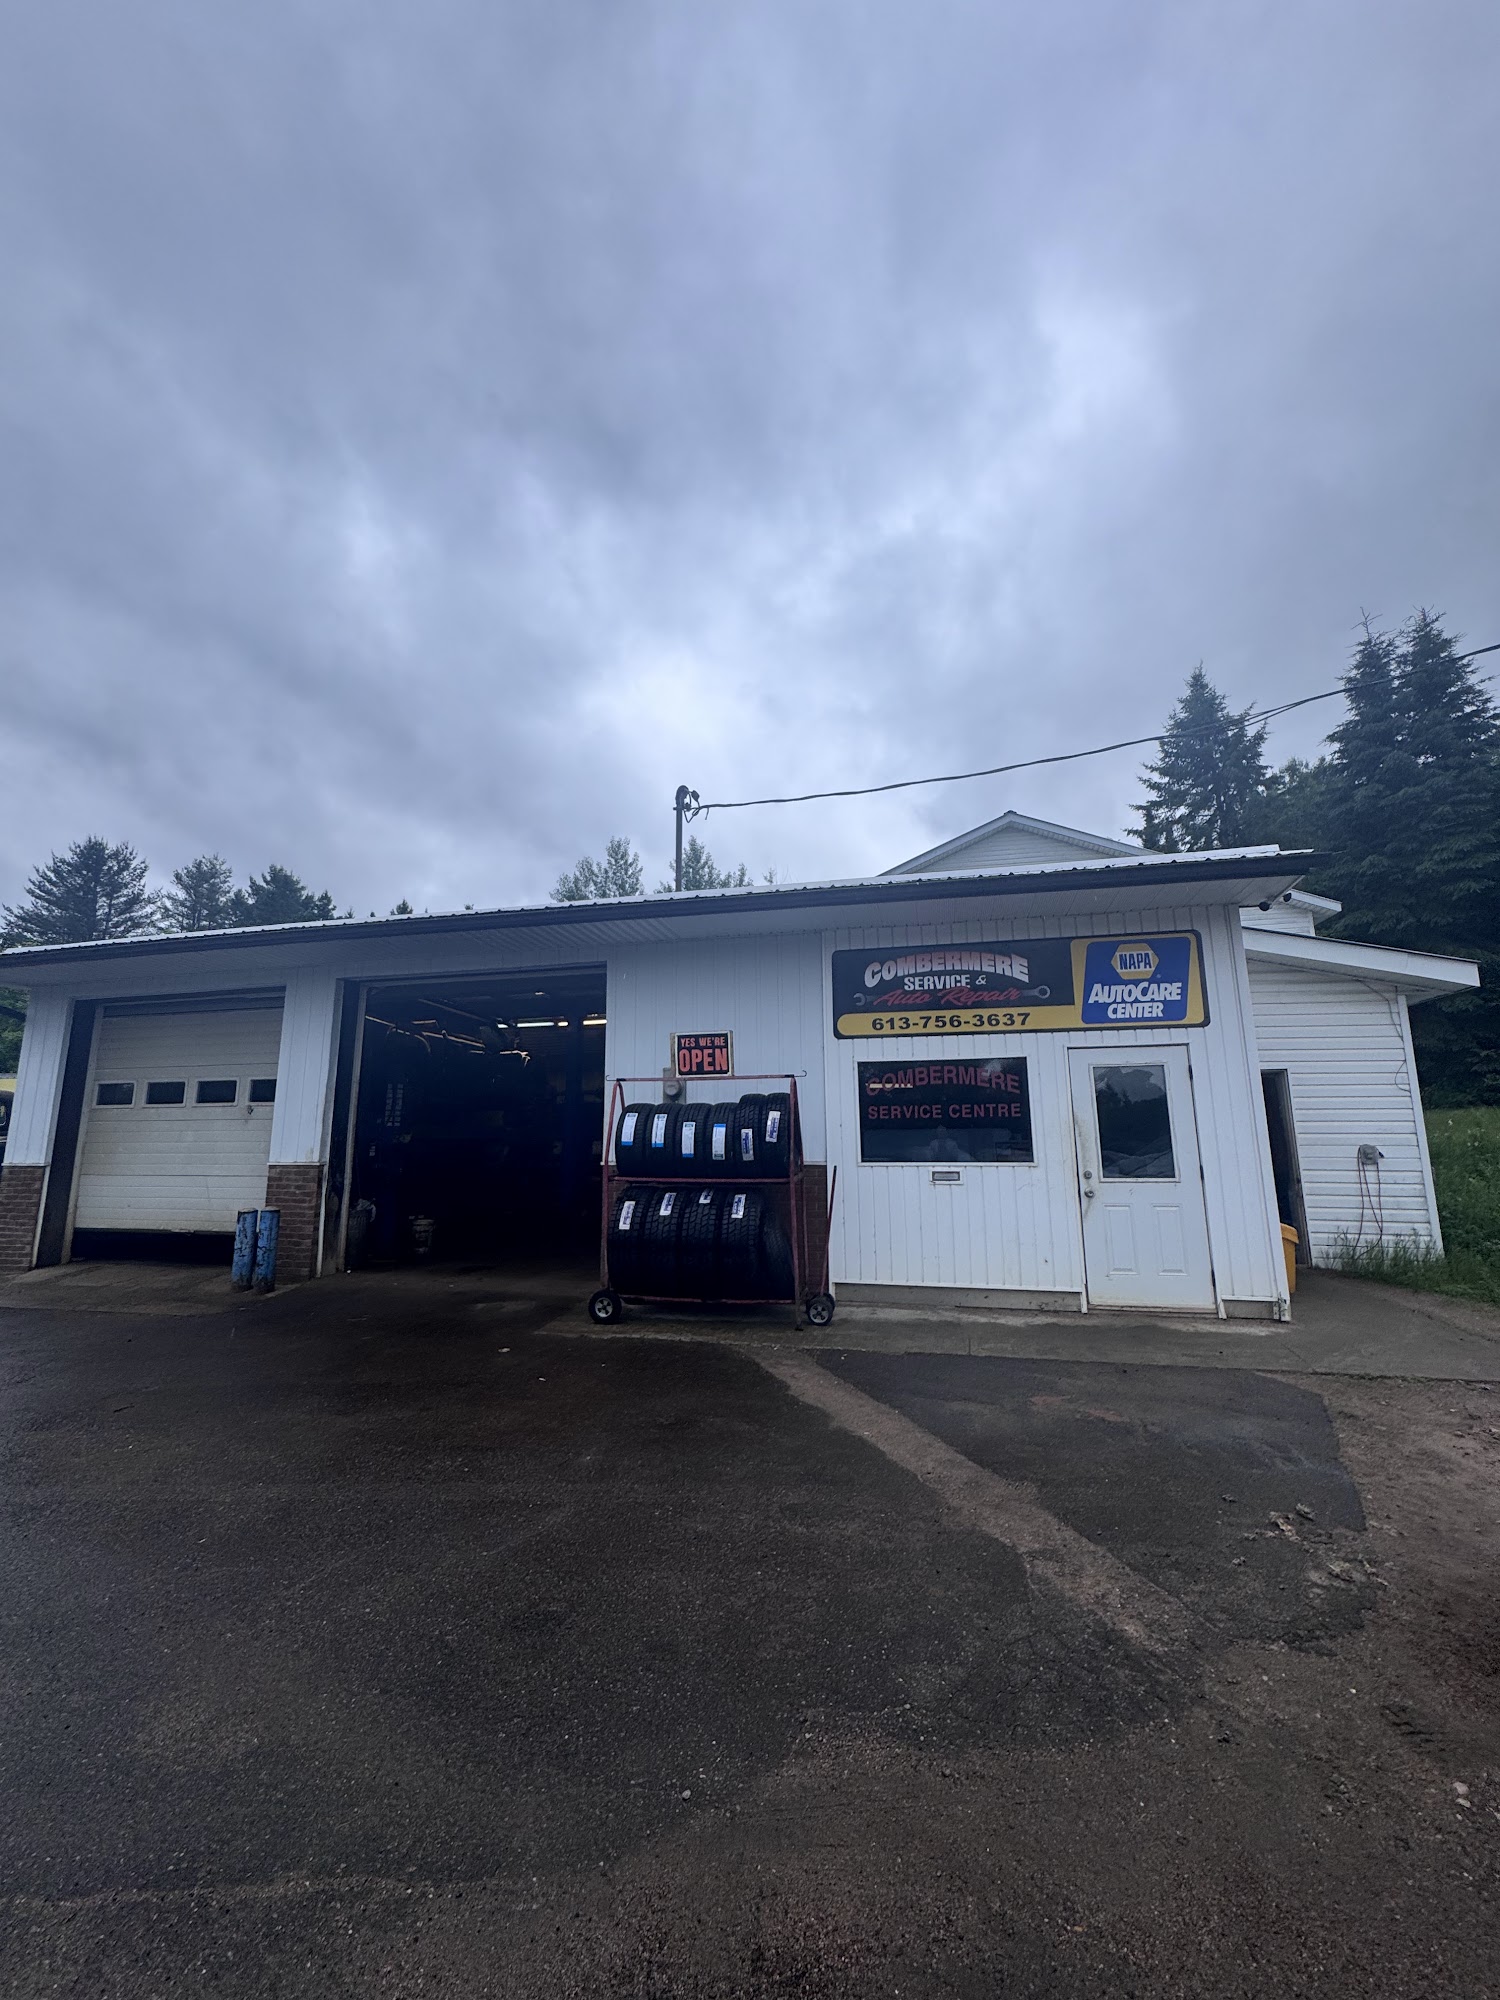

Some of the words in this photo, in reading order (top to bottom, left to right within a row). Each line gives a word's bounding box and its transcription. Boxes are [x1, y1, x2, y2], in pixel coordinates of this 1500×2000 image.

[864, 950, 1029, 988] COMBERMERE
[1118, 952, 1152, 971] NAPA
[904, 974, 971, 991] SERVICE
[975, 974, 987, 985] &
[873, 988, 932, 1006] Auto
[937, 985, 1022, 1005] Repair
[1107, 1002, 1164, 1019] CENTER
[871, 1012, 1031, 1031] 613-756-3637
[680, 1037, 696, 1047] YES
[699, 1036, 726, 1046] WE'RE
[678, 1048, 728, 1072] OPEN
[866, 1065, 1020, 1096] COMBERMERE
[868, 1104, 943, 1119] SERVICE
[948, 1103, 1022, 1118] CENTRE
